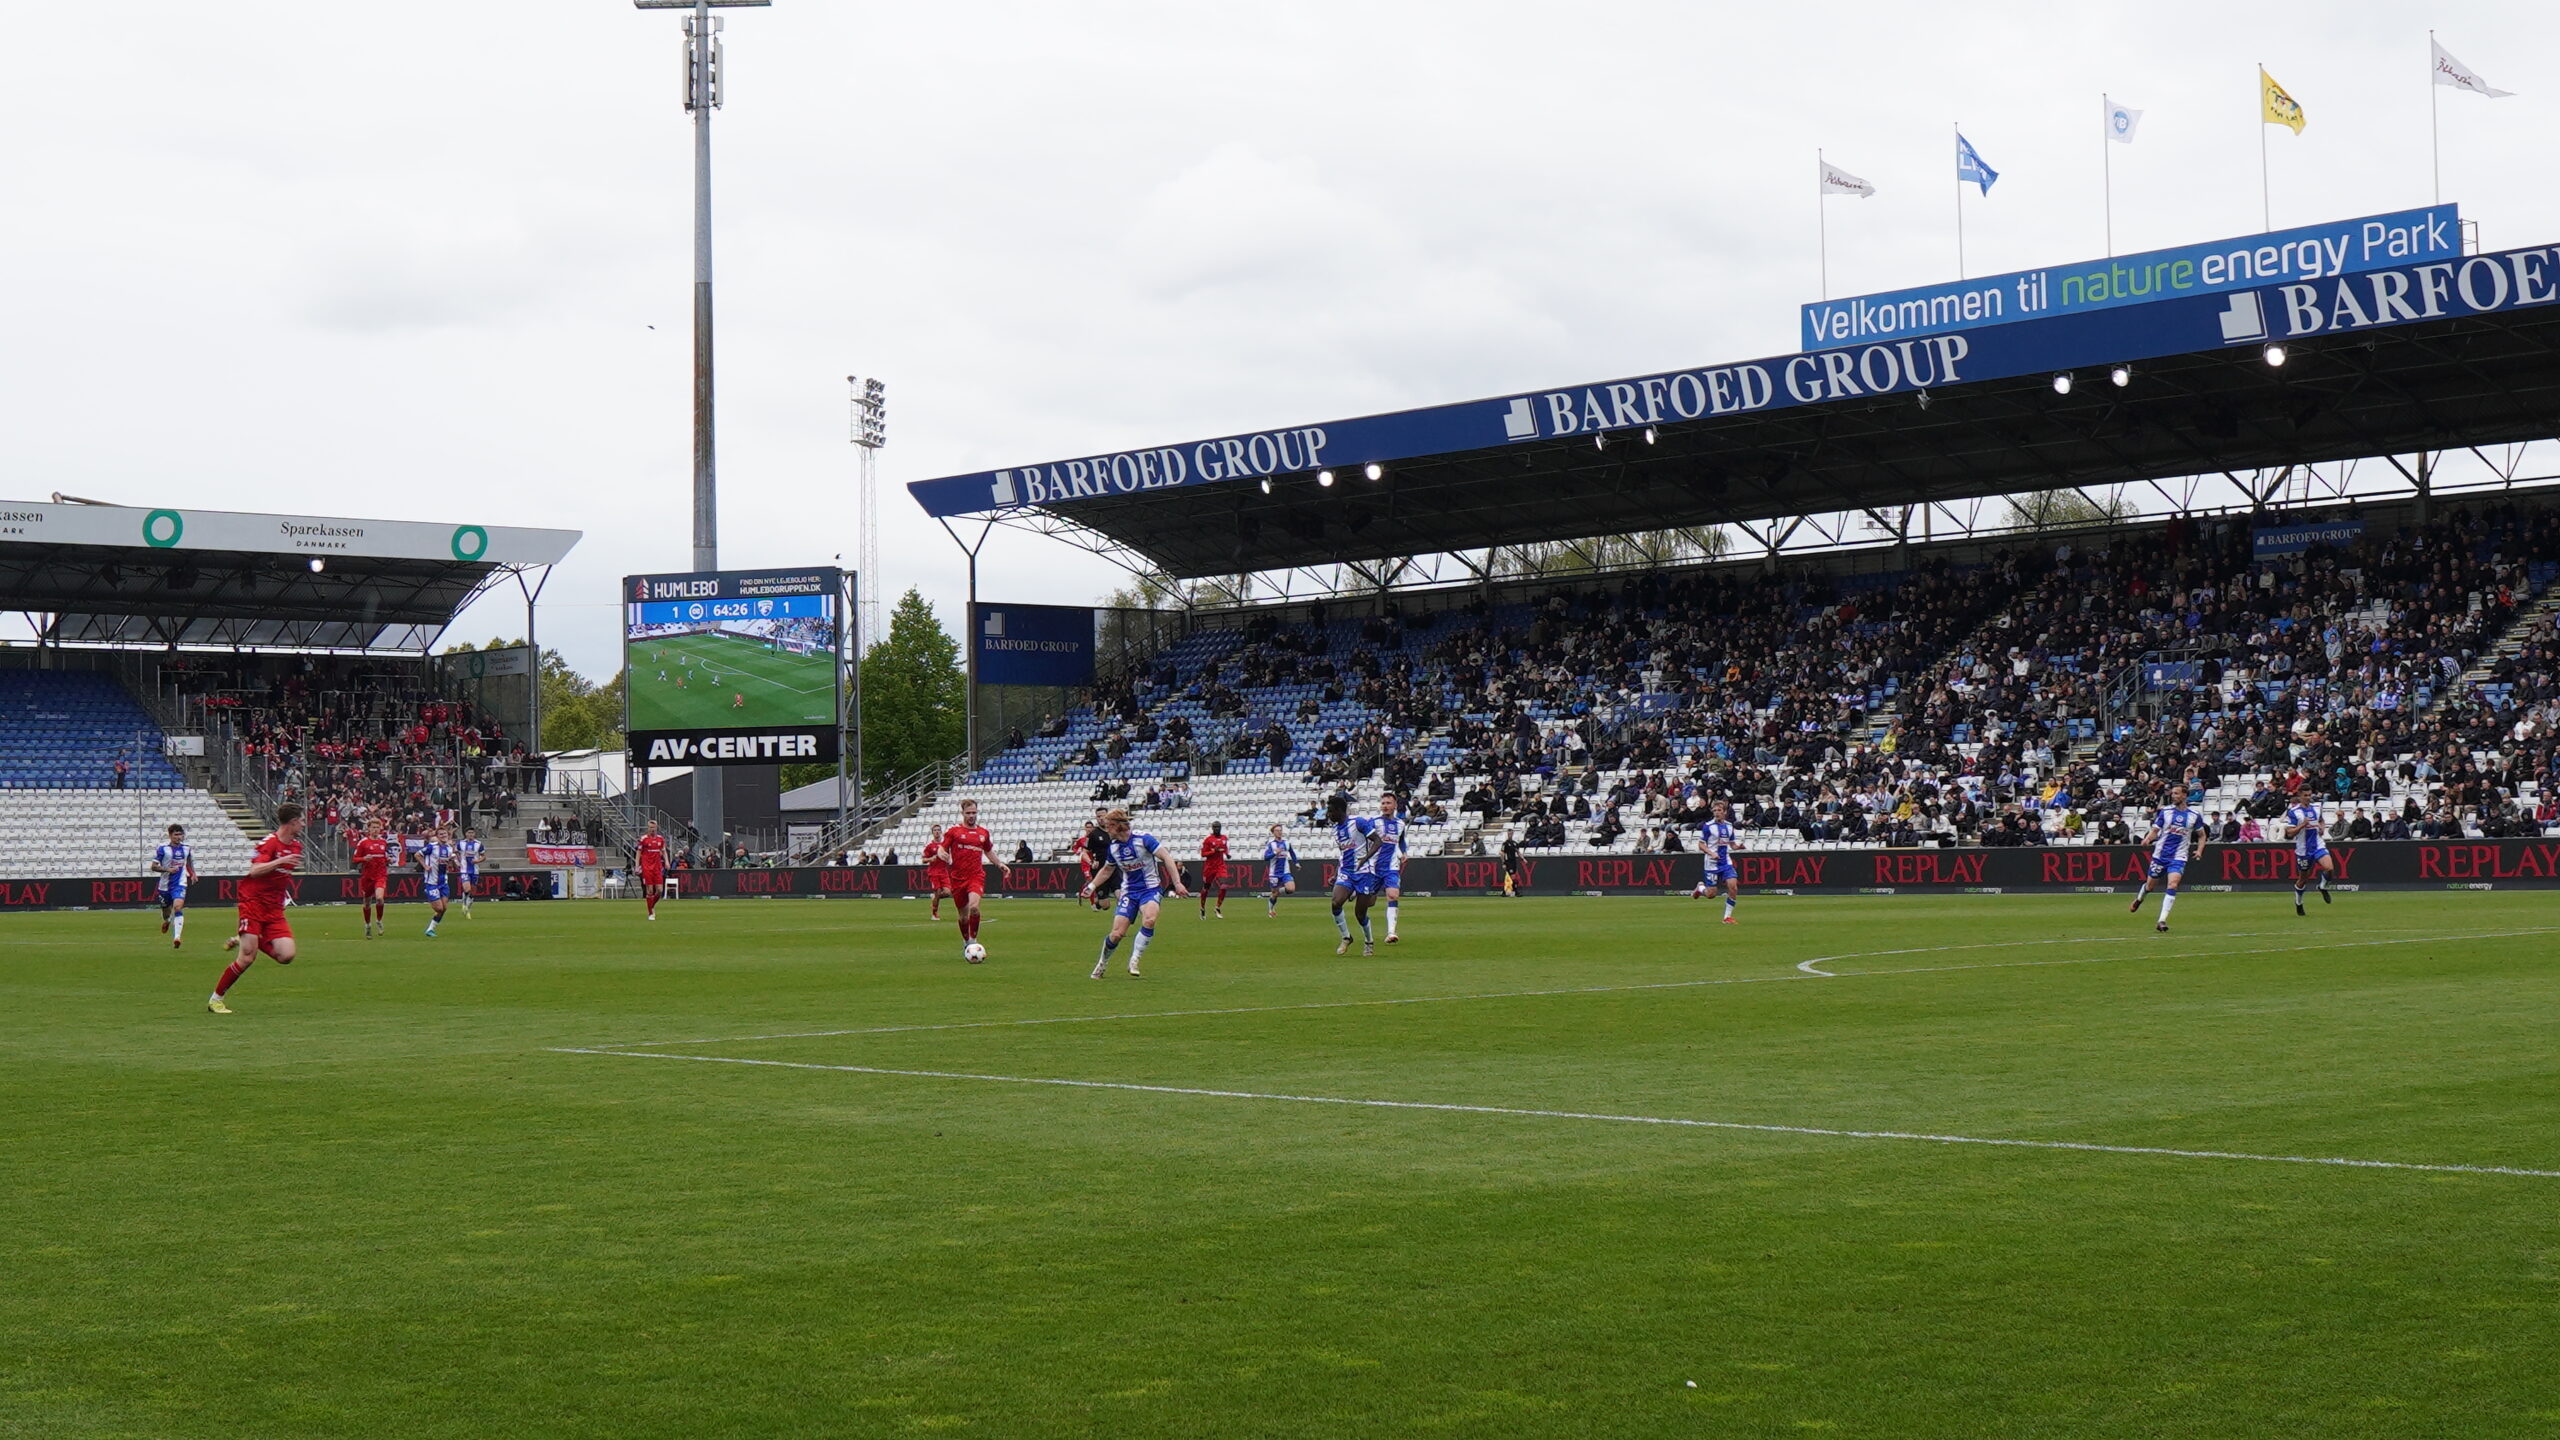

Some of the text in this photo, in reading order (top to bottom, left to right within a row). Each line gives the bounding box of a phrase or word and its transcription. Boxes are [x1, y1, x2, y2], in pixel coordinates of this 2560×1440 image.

[1808, 212, 2449, 342] Velkommen til nature energy Park
[2278, 245, 2560, 336] BARFOE
[1544, 335, 1969, 436] BARFOED GROUP
[1019, 427, 1327, 505] BARFOED GROUP
[280, 521, 365, 538] Sparekassen
[296, 540, 347, 549] DANMARK
[654, 580, 719, 599] HUMLEBO
[740, 583, 822, 595] HUMLEBOGRUPPEN.DK
[672, 606, 679, 618] 1
[713, 603, 748, 617] 64:26
[783, 601, 790, 613] 1
[985, 638, 1079, 653] BARFOED GROUP
[1002, 868, 1070, 890] REPLAY
[1578, 860, 1678, 886] REPLAY
[1874, 854, 1989, 883] REPLAY
[737, 872, 795, 893] REPLAY
[819, 869, 881, 891] REPLAY
